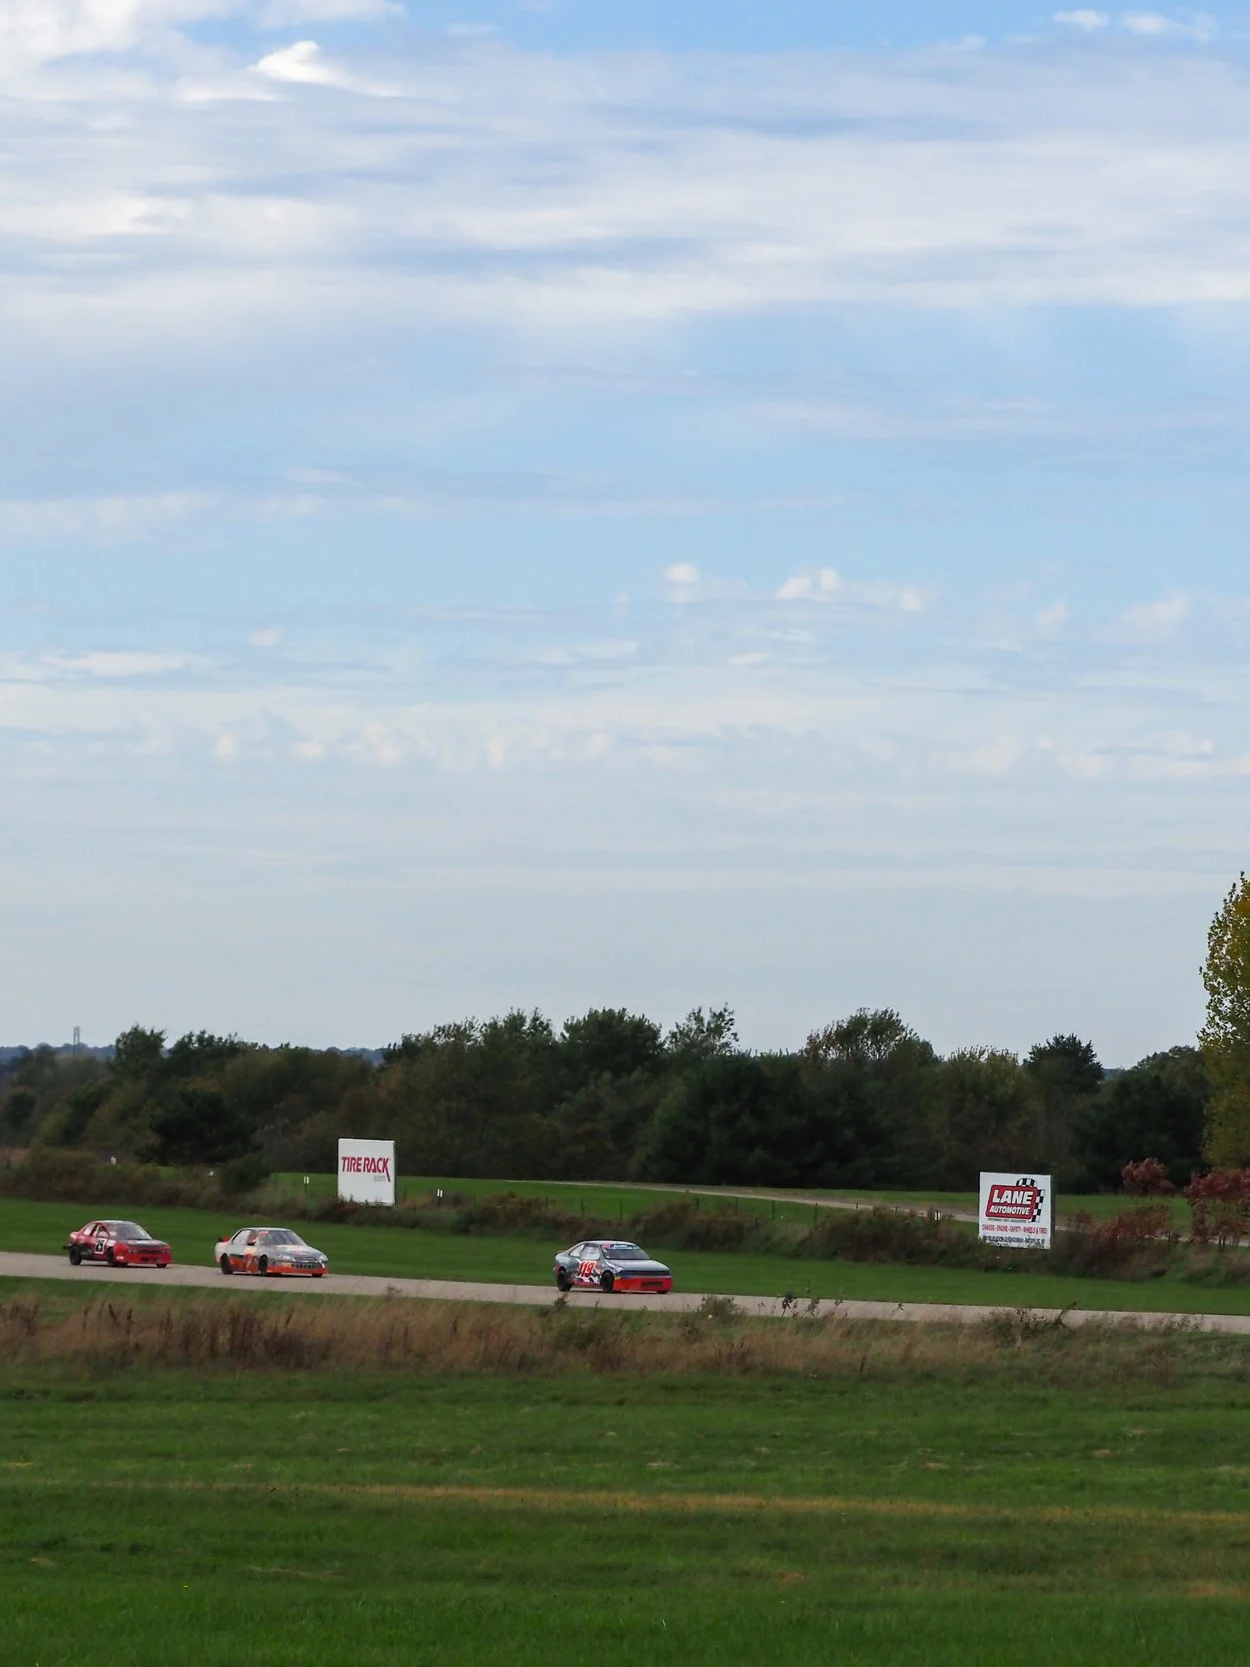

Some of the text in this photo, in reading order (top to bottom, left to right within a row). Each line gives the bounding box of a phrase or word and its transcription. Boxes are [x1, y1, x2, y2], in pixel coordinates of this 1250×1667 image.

[341, 1156, 391, 1183] TIRE RACK
[992, 1189, 1034, 1205] LANE
[989, 1205, 1031, 1215] AUTOMOTIVE
